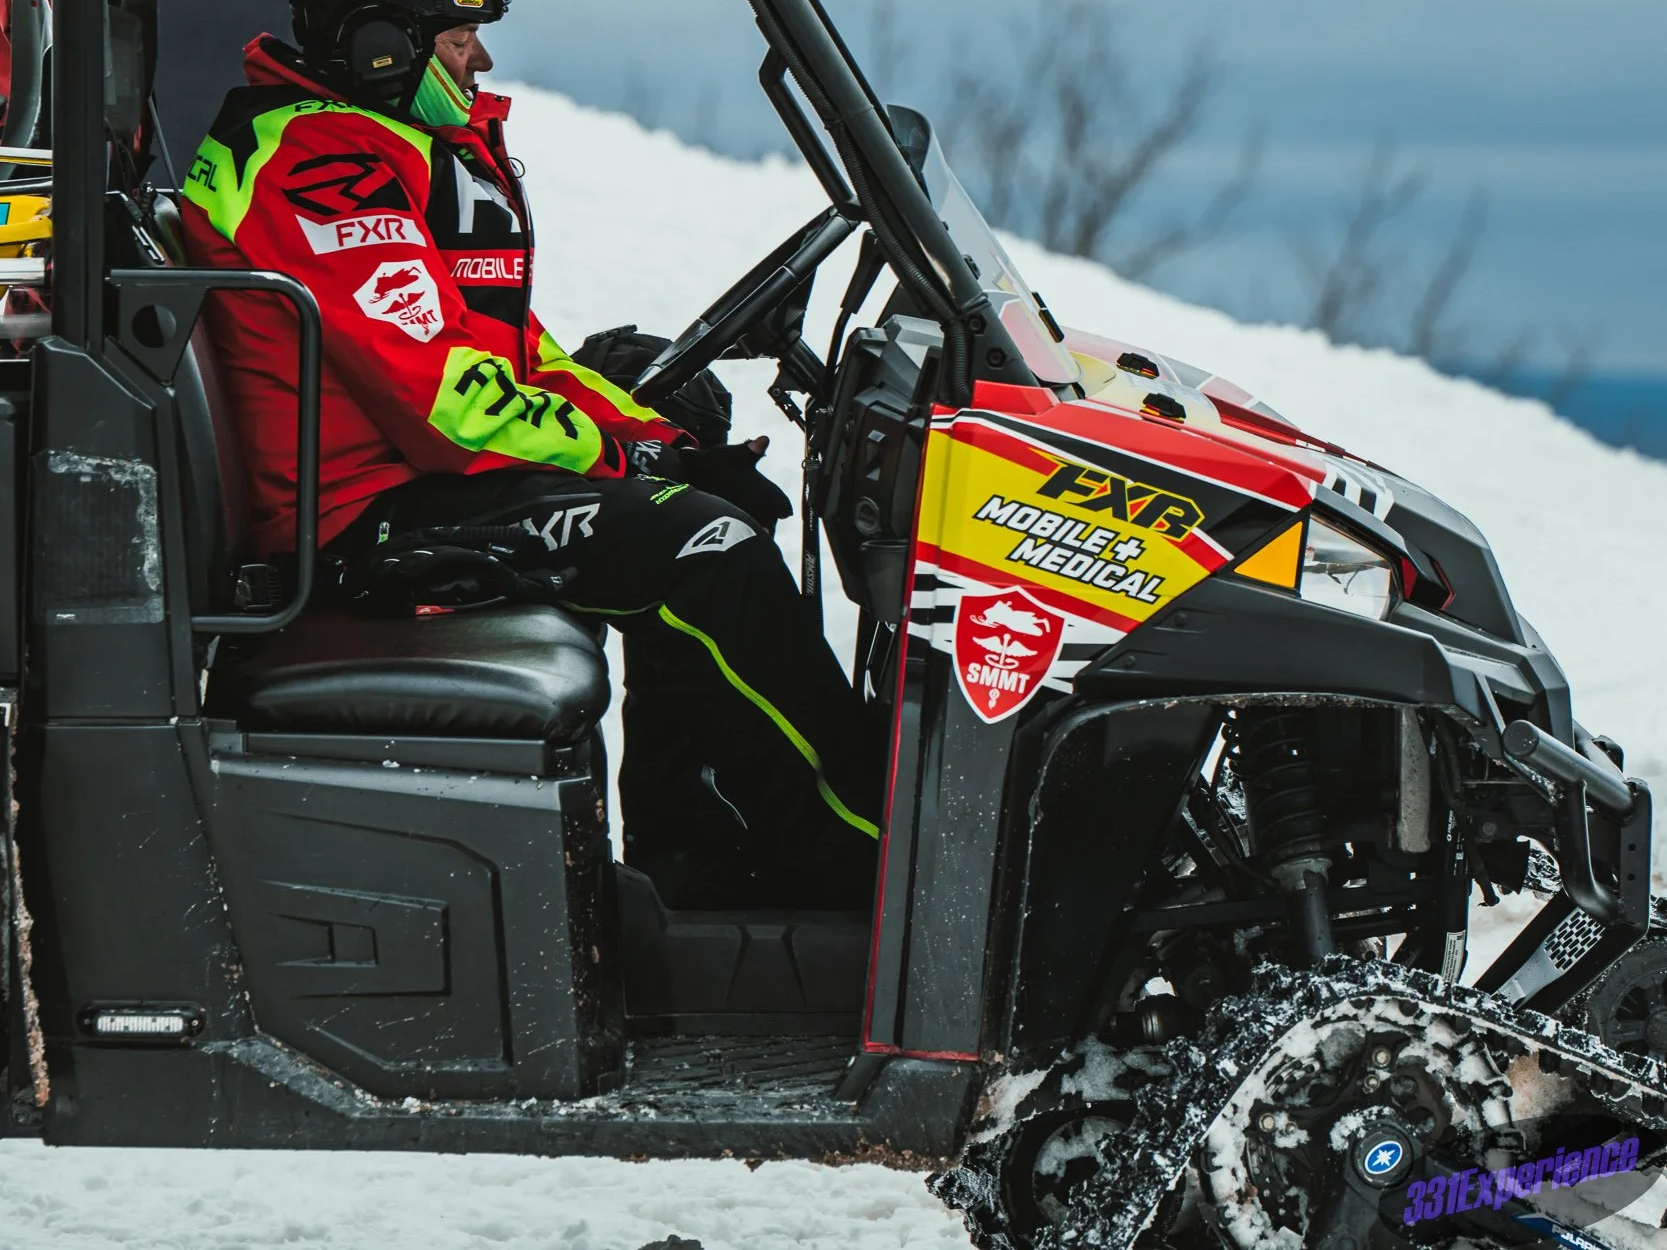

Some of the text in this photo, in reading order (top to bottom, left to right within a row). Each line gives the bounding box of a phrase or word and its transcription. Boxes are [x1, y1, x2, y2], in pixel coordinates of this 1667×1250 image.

[335, 217, 406, 247] FXR
[450, 257, 524, 280] MOBILE
[1035, 456, 1203, 541] FXR
[508, 502, 601, 552] XR
[973, 495, 1119, 555] MOBILE
[1006, 535, 1165, 605] MEDICAL
[966, 662, 1031, 694] SMMT
